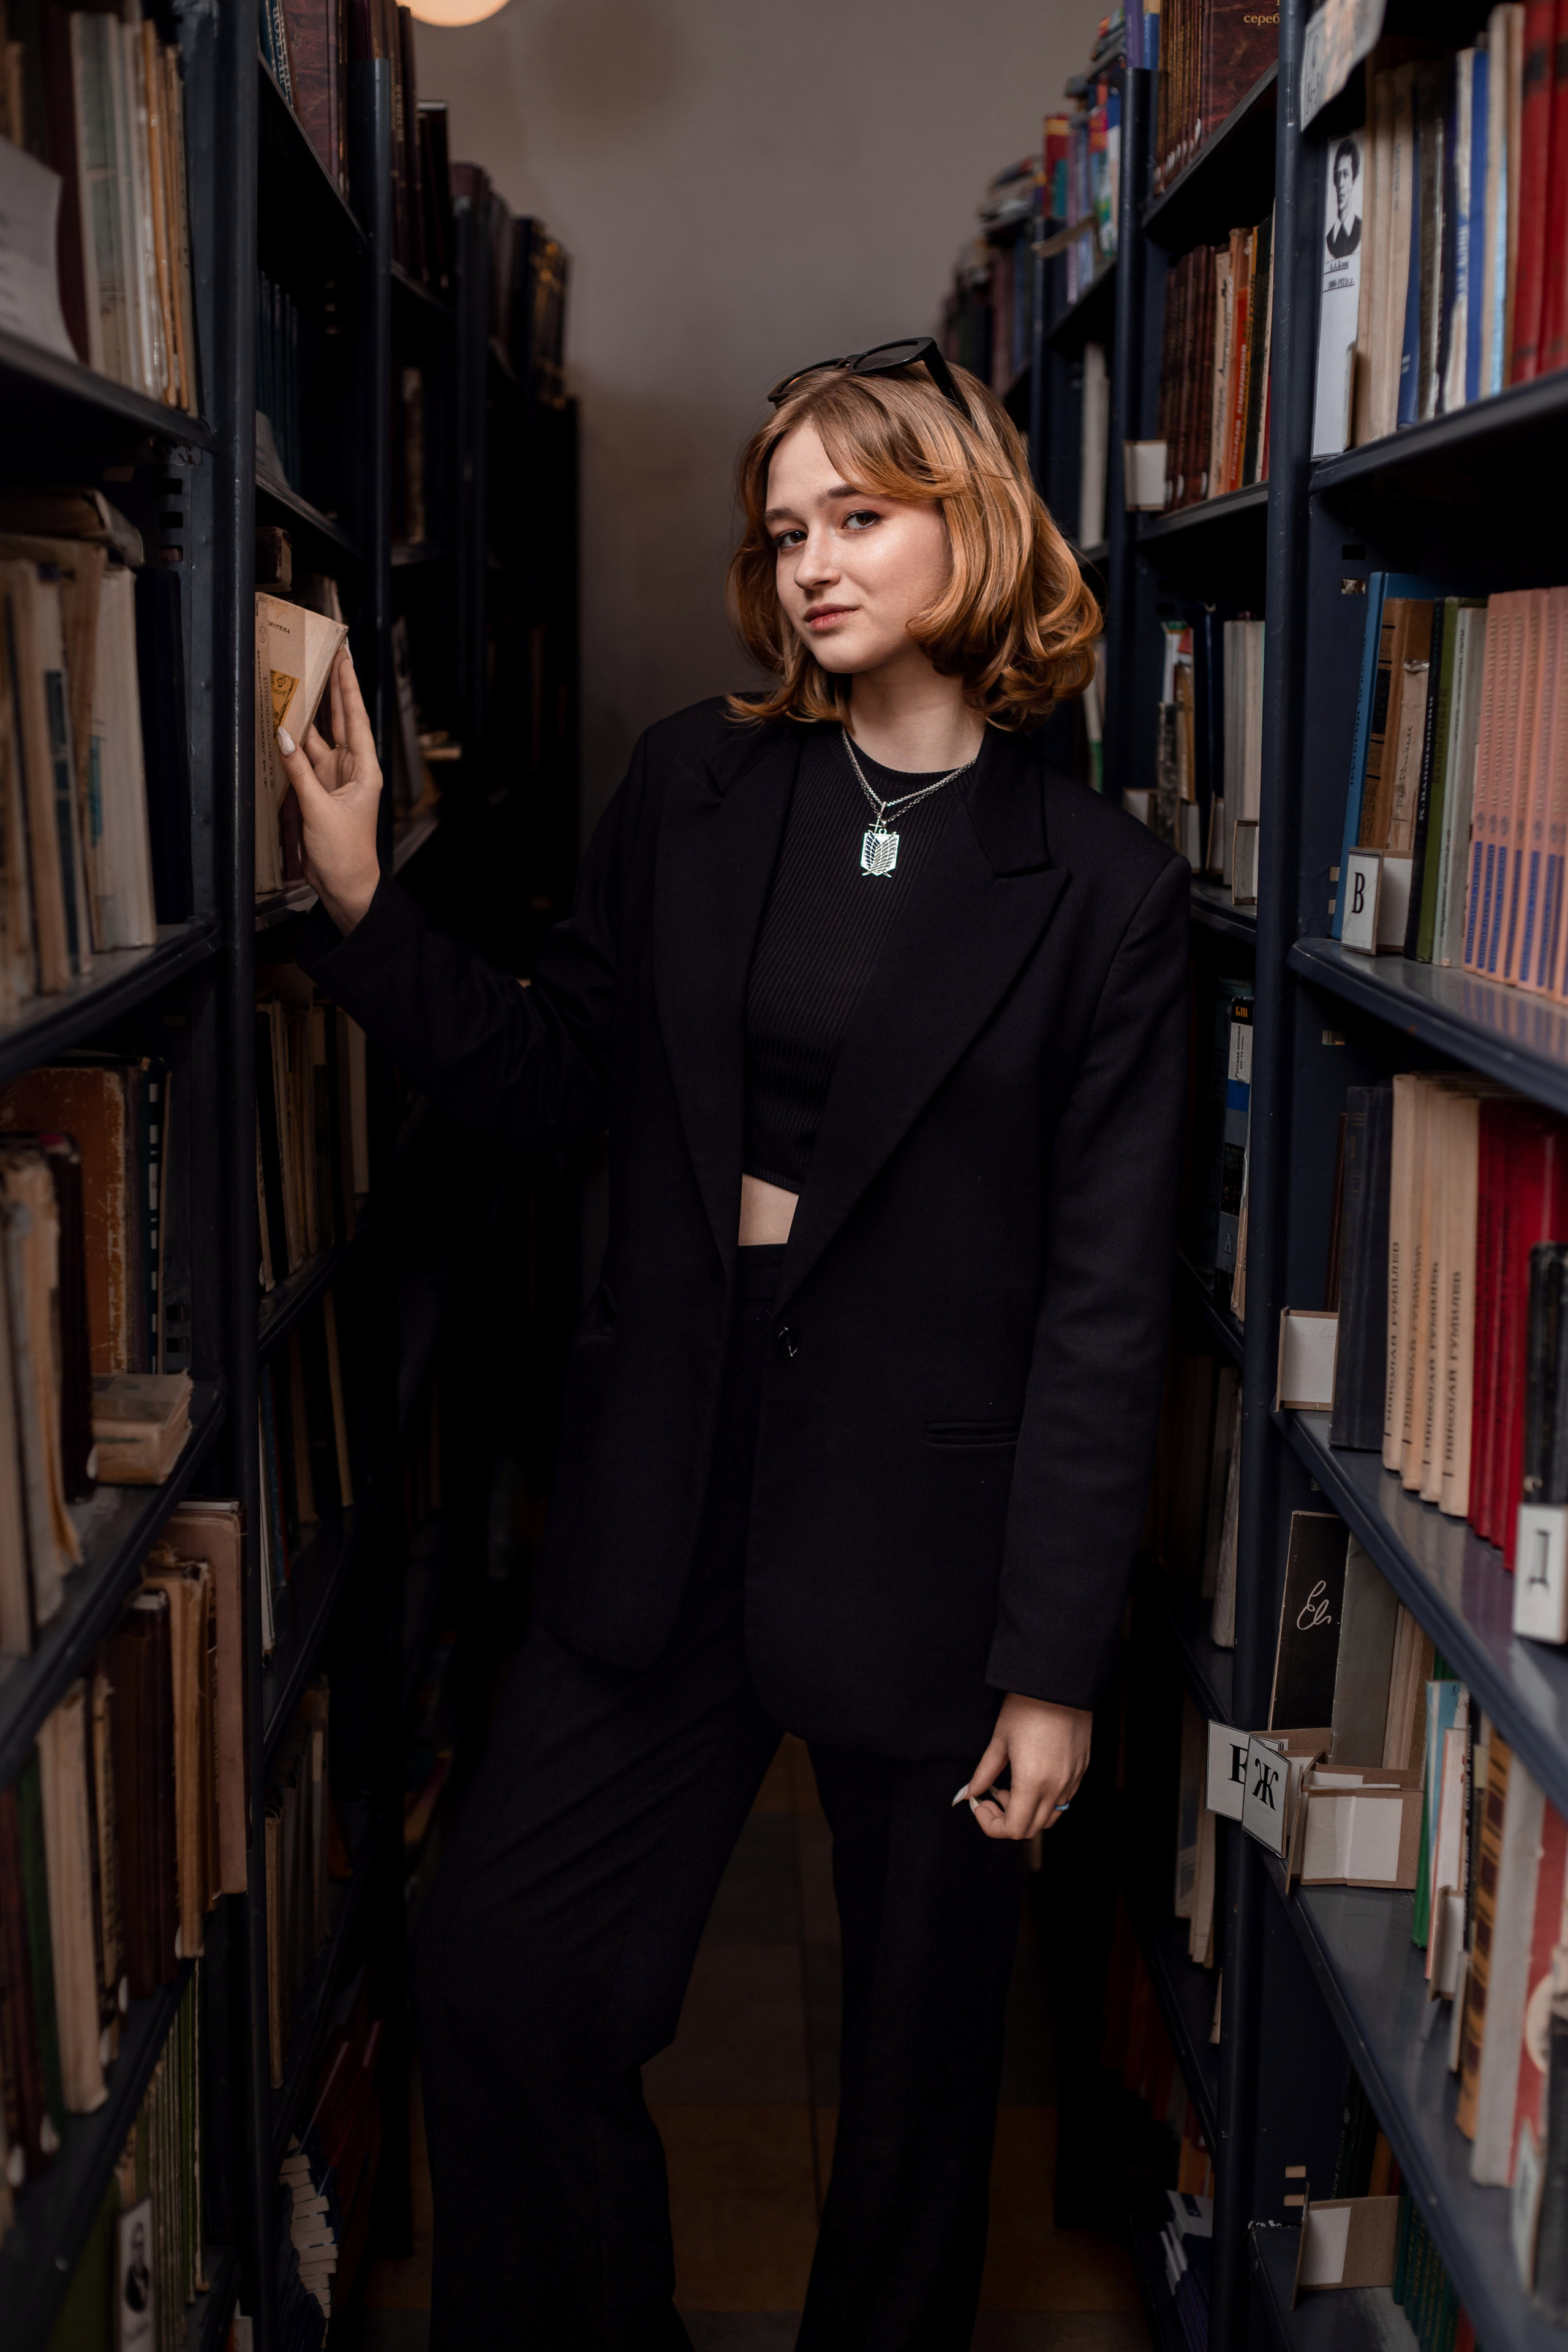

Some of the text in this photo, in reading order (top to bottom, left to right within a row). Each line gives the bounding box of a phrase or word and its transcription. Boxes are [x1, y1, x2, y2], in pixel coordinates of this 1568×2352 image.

[273, 6, 286, 84] ЛЕСКОВ
[1243, 13, 1280, 26] сереб
[268, 620, 290, 634] ИОТЕКА
[263, 677, 274, 790] Ф М ДОСТОЕВСКИЙ
[1349, 710, 1361, 786] ВАЛЕРИЙ
[1352, 872, 1365, 914] В
[1386, 1241, 1400, 1421] НИКОЛАЙ ГУМИЛЕВ
[1423, 1262, 1439, 1449] НИКОЛАЙ ГУМИЛЕВ
[1444, 1271, 1461, 1460] НИКОЛАЙ ГУМИЛЕВ
[1251, 1757, 1279, 1811] Ж
